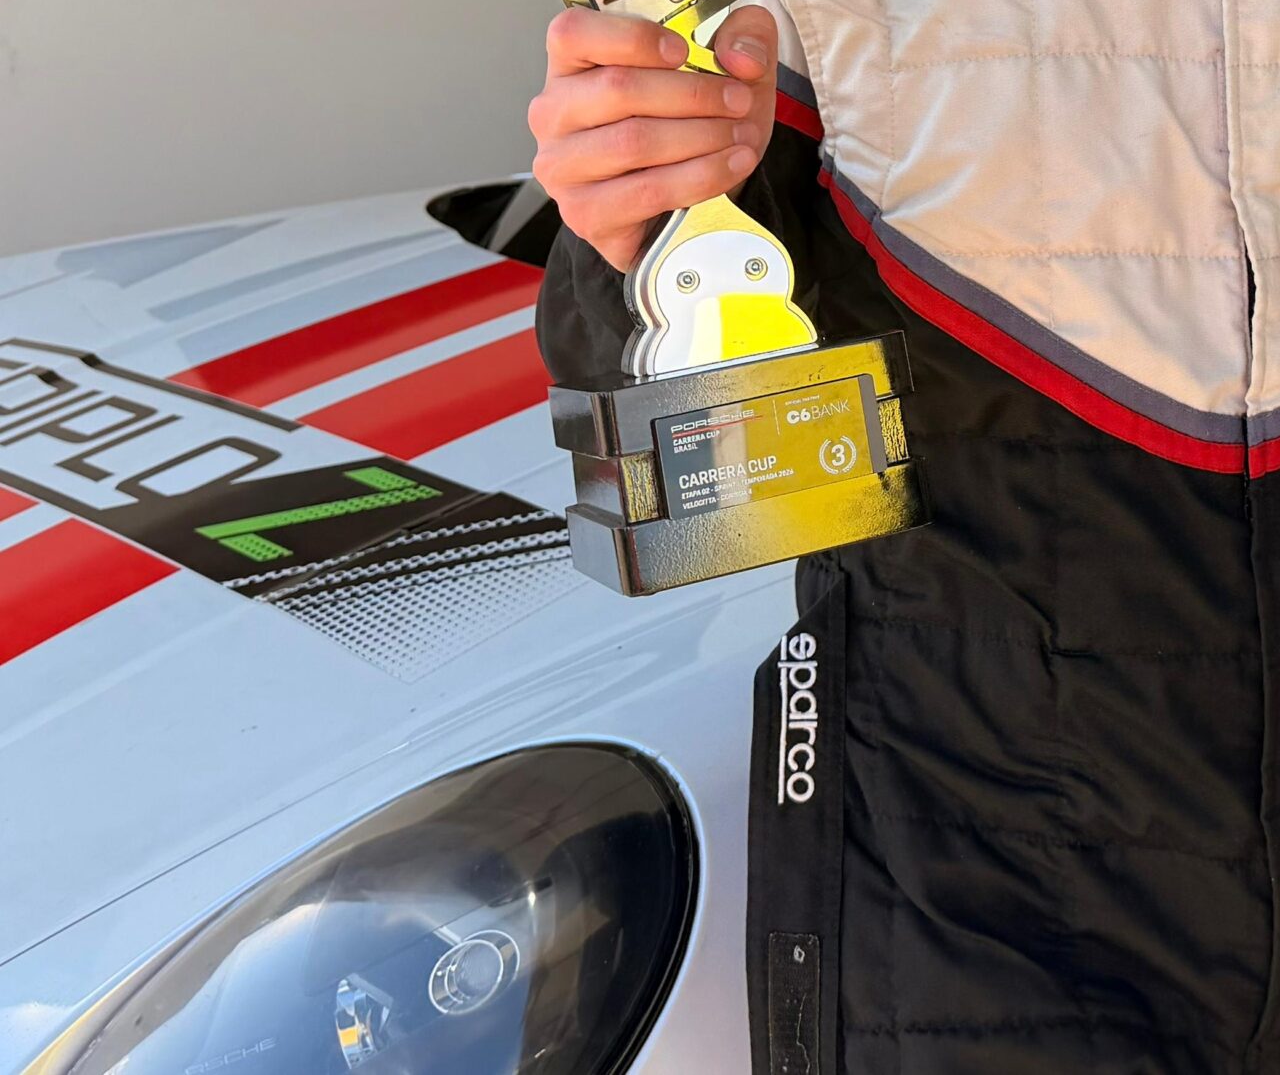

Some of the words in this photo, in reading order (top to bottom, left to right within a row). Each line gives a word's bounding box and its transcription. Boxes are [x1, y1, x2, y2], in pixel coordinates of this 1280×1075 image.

[671, 409, 755, 433] PORSCHE
[673, 434, 706, 446] CARRERA
[706, 430, 720, 438] CUP
[674, 443, 698, 454] BRASIL
[831, 444, 846, 467] 3
[679, 462, 747, 489] CARRERA
[748, 455, 777, 474] CUP
[778, 632, 819, 804] sparco
[185, 1036, 277, 1075] RSCHE
